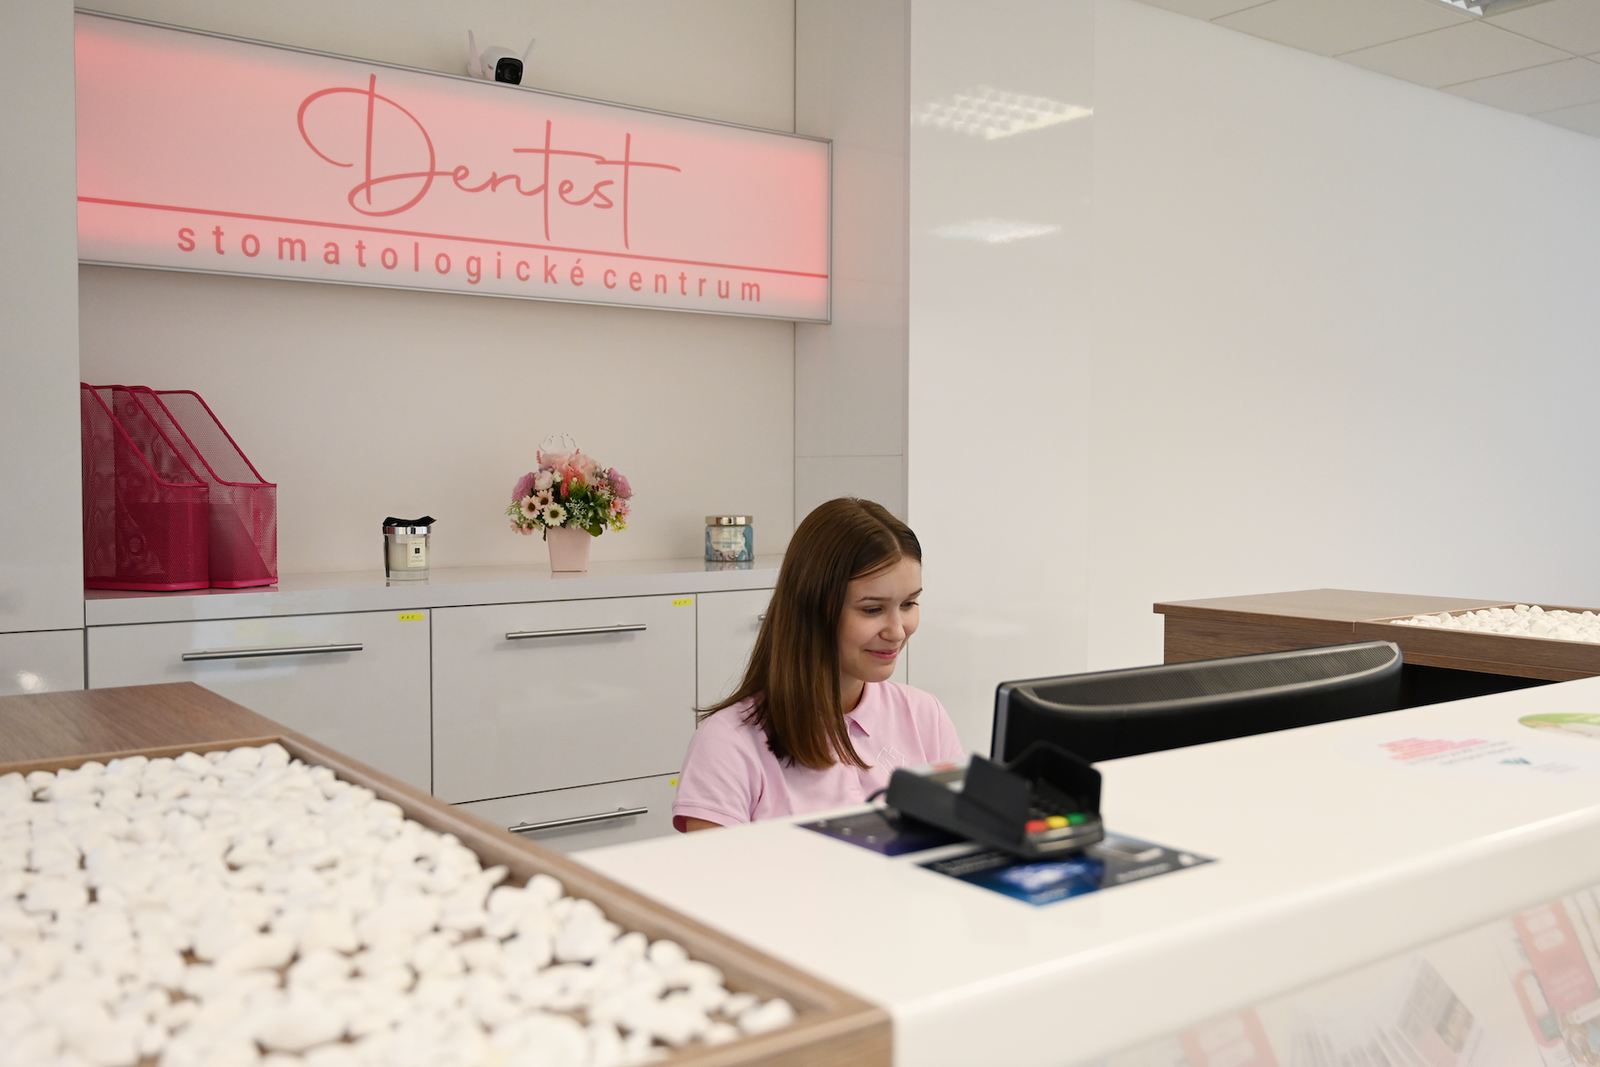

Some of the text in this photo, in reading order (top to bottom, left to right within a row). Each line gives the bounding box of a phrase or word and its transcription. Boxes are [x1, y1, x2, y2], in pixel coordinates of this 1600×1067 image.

[297, 74, 682, 250] Dentest
[177, 226, 762, 303] stomatologické centrum
